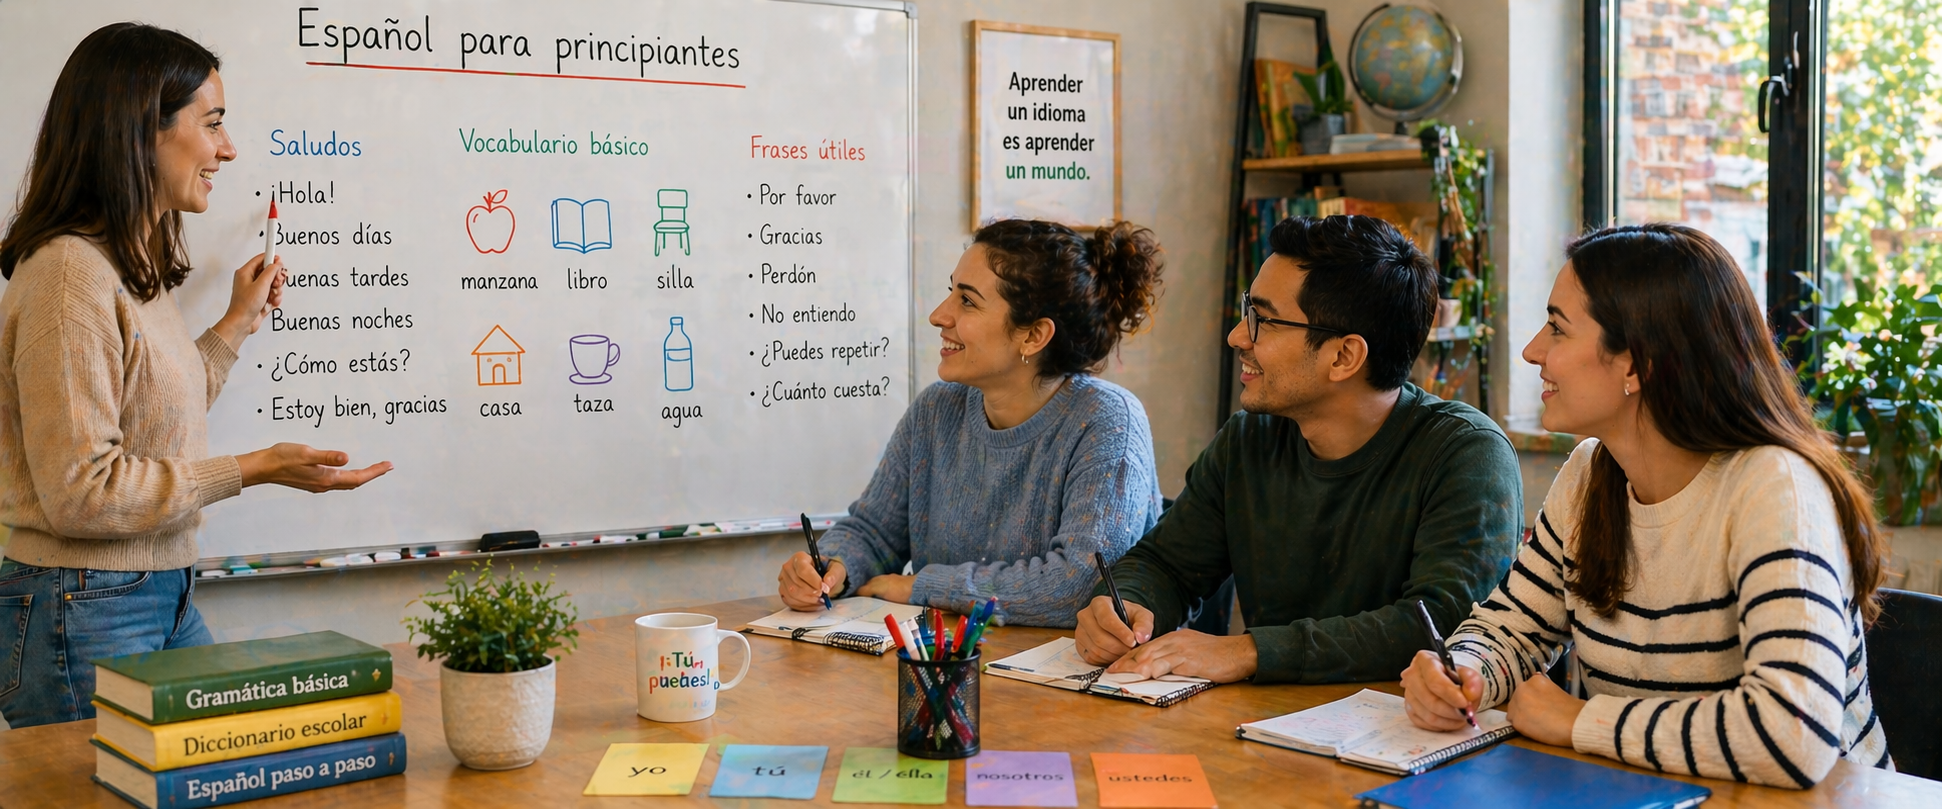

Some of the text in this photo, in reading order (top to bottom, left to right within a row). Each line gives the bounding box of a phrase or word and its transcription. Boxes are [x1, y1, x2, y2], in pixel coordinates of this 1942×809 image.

[298, 7, 740, 77] Español para principiantes
[1008, 71, 1084, 97] Aprender
[1007, 102, 1086, 123] un idioma
[269, 128, 362, 157] Saludos
[458, 127, 649, 156] Vocabulario básico
[751, 134, 866, 162] Frases útiles
[1002, 132, 1095, 156] es aprender
[1006, 161, 1091, 181] un mundo.
[270, 180, 334, 204] ¡Hola!
[760, 183, 837, 206] Por favor
[275, 221, 392, 246] Buenos días
[759, 223, 823, 245] Gracias
[282, 264, 409, 288] uenas tardes
[461, 276, 539, 290] manzana
[567, 267, 608, 290] libro
[657, 263, 695, 290] silla
[761, 262, 816, 285] Perdón
[271, 307, 414, 332] Buenas noches
[762, 302, 856, 324] No entiendo
[761, 336, 890, 368] ¿Puedes repetir?
[271, 348, 411, 382] ¿Cómo estás?
[573, 393, 615, 413] taza
[761, 375, 890, 408] ¿Cuánto cuesta?
[272, 394, 447, 429] Estoy bien, gracias
[479, 401, 523, 418] casa
[661, 405, 703, 429] agua
[186, 672, 349, 710] Gramática básica
[183, 713, 367, 757] Diccionario escolar
[187, 755, 376, 802] Español paso a paso
[628, 766, 667, 777] yo
[752, 765, 786, 776] tú
[976, 772, 1064, 781] nosotros
[1109, 774, 1193, 782] ustedes
